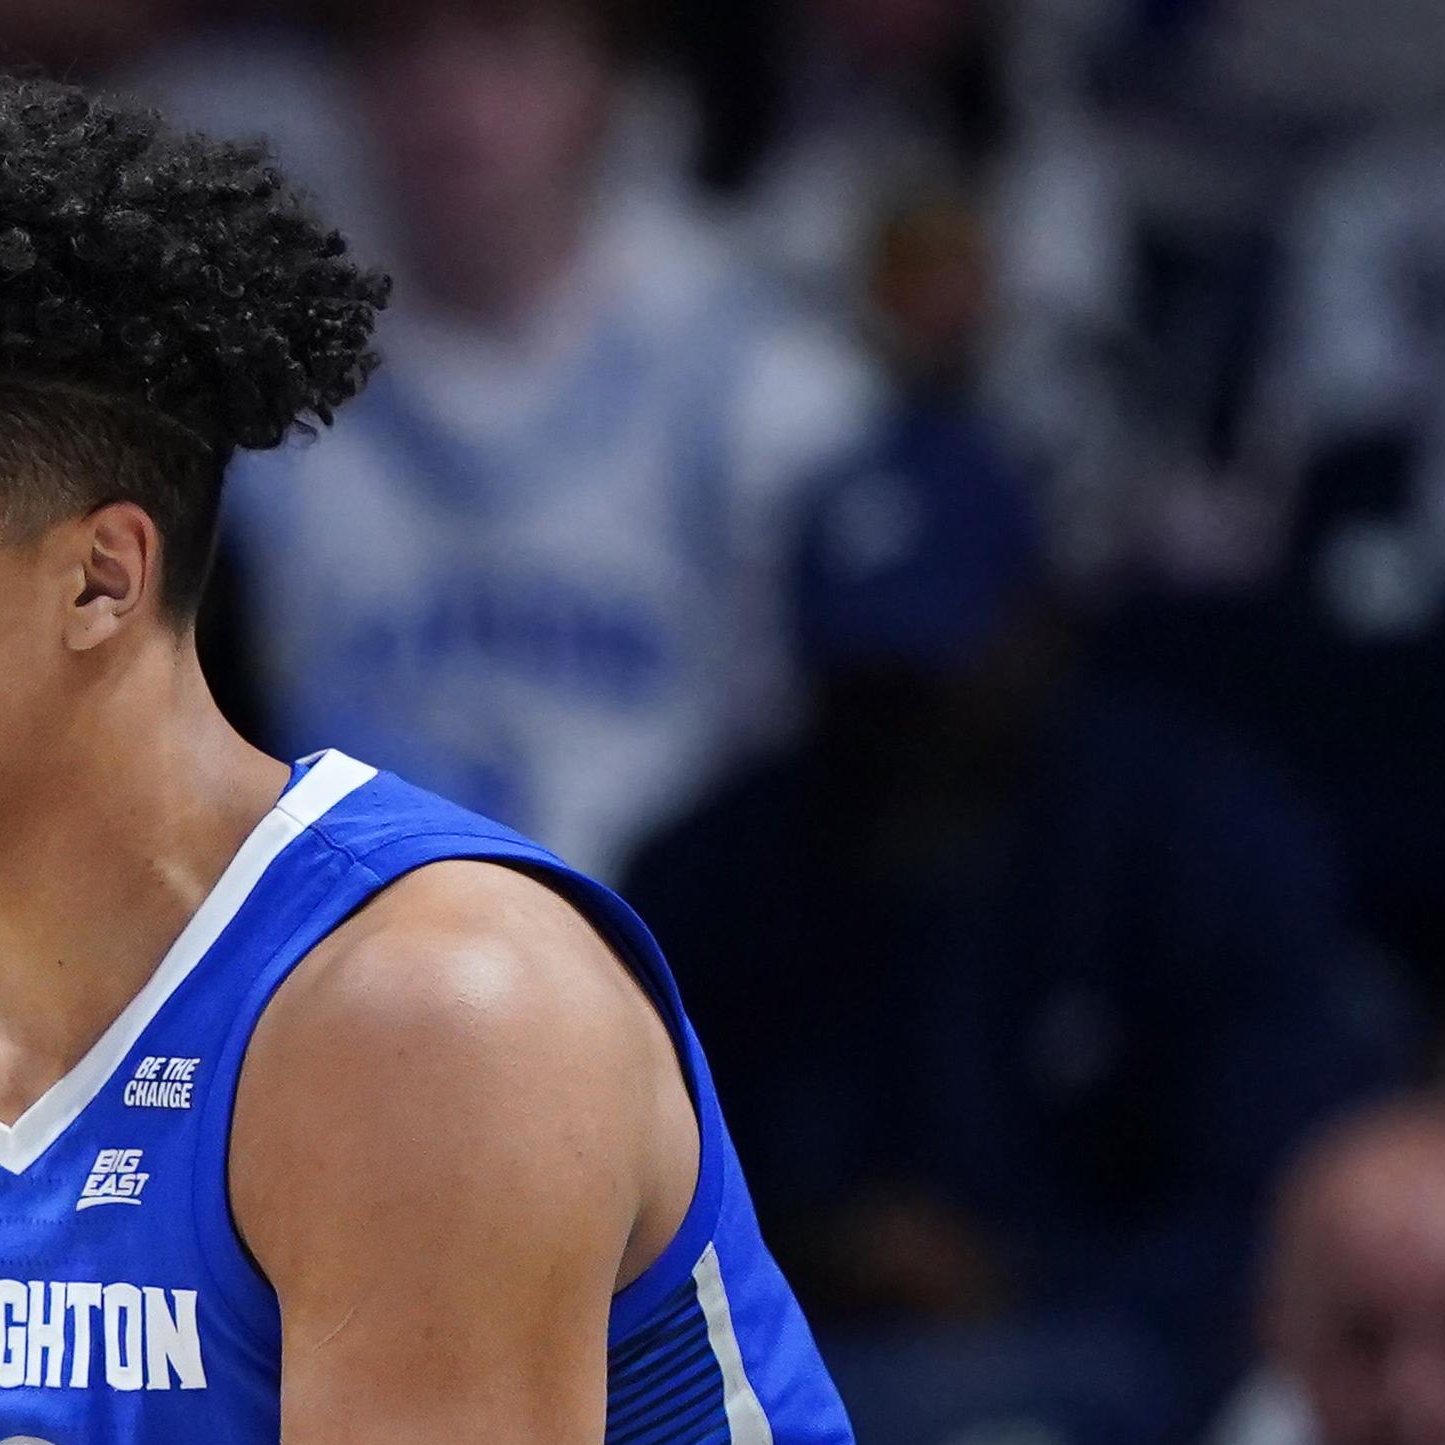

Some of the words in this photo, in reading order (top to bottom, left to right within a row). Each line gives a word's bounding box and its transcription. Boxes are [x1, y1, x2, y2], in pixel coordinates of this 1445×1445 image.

[135, 1056, 165, 1080] BE
[162, 1057, 201, 1081] THE
[123, 1080, 194, 1109] CHANGE
[91, 1149, 144, 1174] BIG
[81, 1173, 150, 1197] EAST
